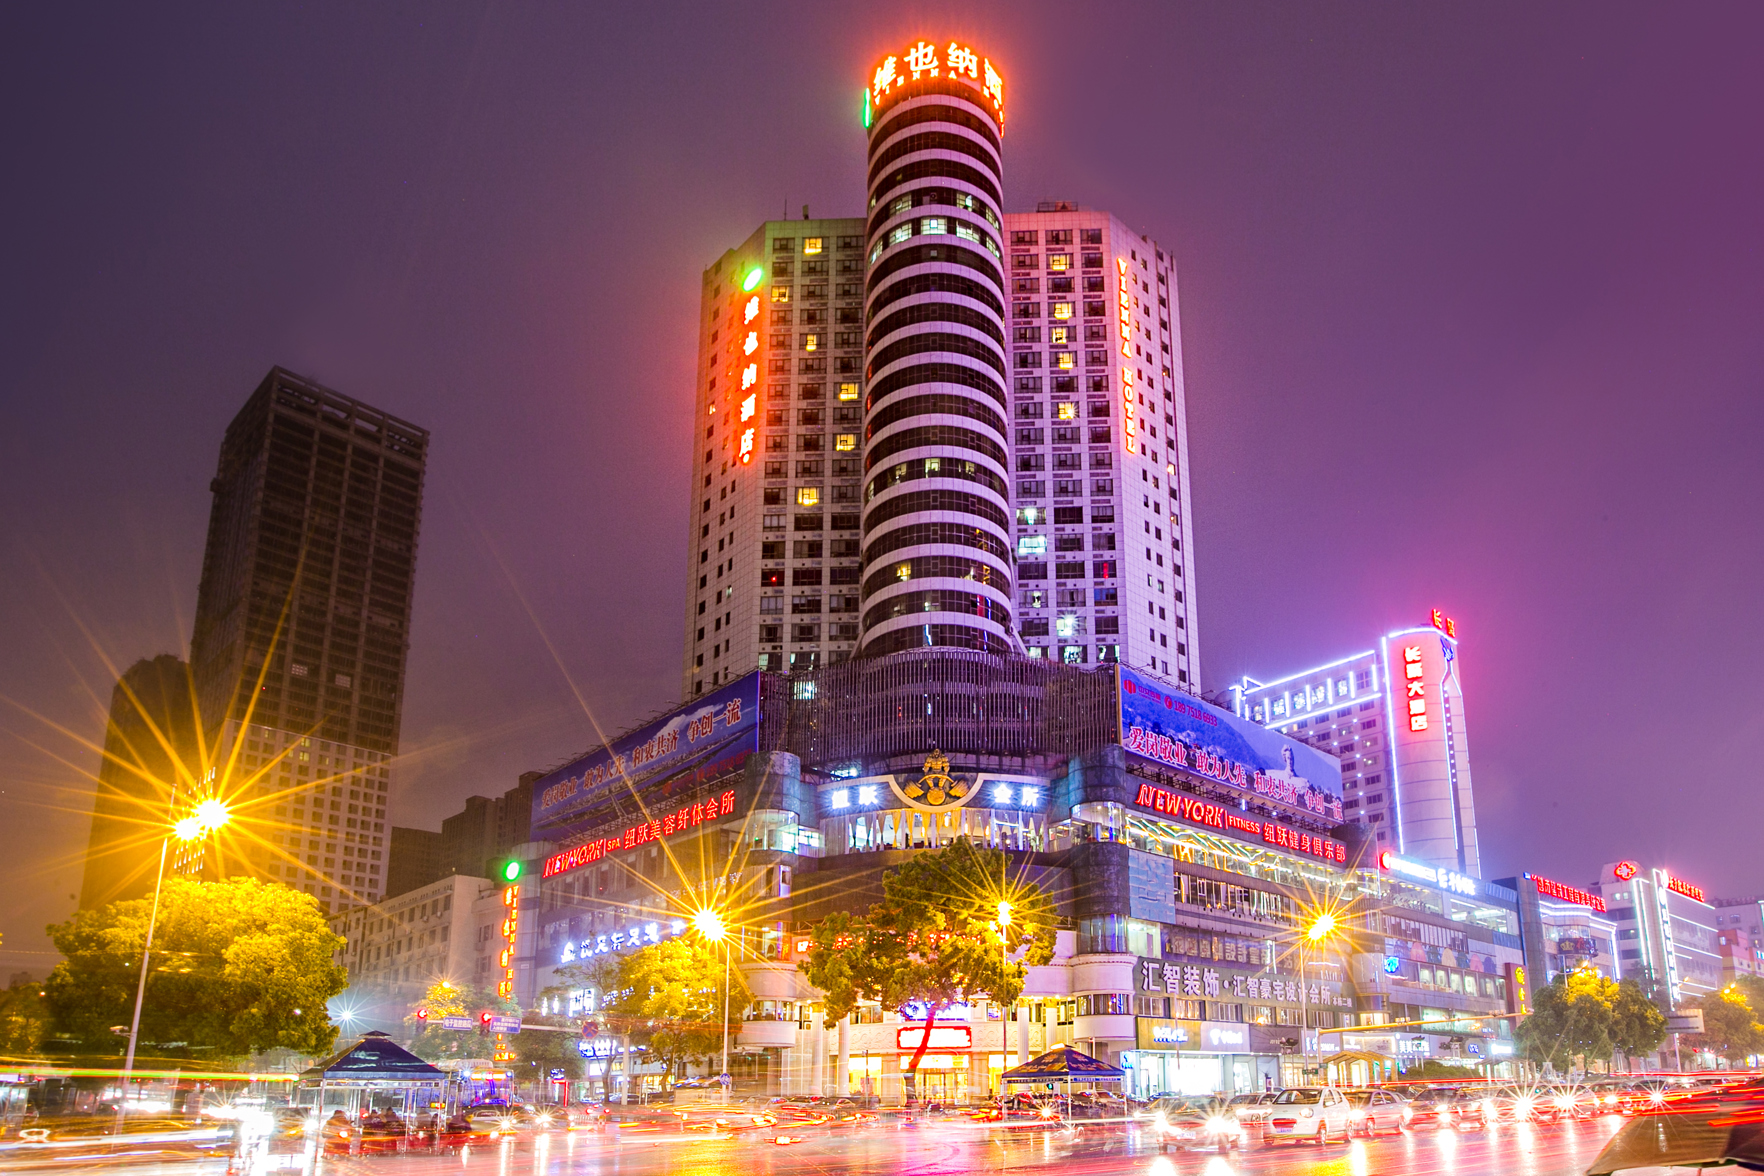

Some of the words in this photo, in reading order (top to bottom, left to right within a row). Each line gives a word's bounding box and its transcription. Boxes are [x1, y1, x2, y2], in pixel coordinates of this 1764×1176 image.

[1117, 258, 1131, 358] VIENNA
[1123, 367, 1135, 454] HOTEL
[541, 775, 577, 808] 爱岗敬业
[583, 755, 626, 790] 敢为人先
[632, 729, 678, 768] 和衷共济
[687, 698, 741, 743] 争创一流
[1187, 705, 1202, 721] 7518
[1203, 711, 1218, 727] 6933
[1129, 726, 1188, 767] 爱岗敬业
[1196, 749, 1247, 788] 敢为人先
[1254, 771, 1299, 806] 和衷共济
[1304, 789, 1344, 821] 争创一流
[607, 837, 621, 852] SPA
[623, 790, 735, 850] 纽跃美容纤体会所
[1228, 815, 1261, 834] FITNESS
[1263, 821, 1347, 864] 纽跃健身俱乐部
